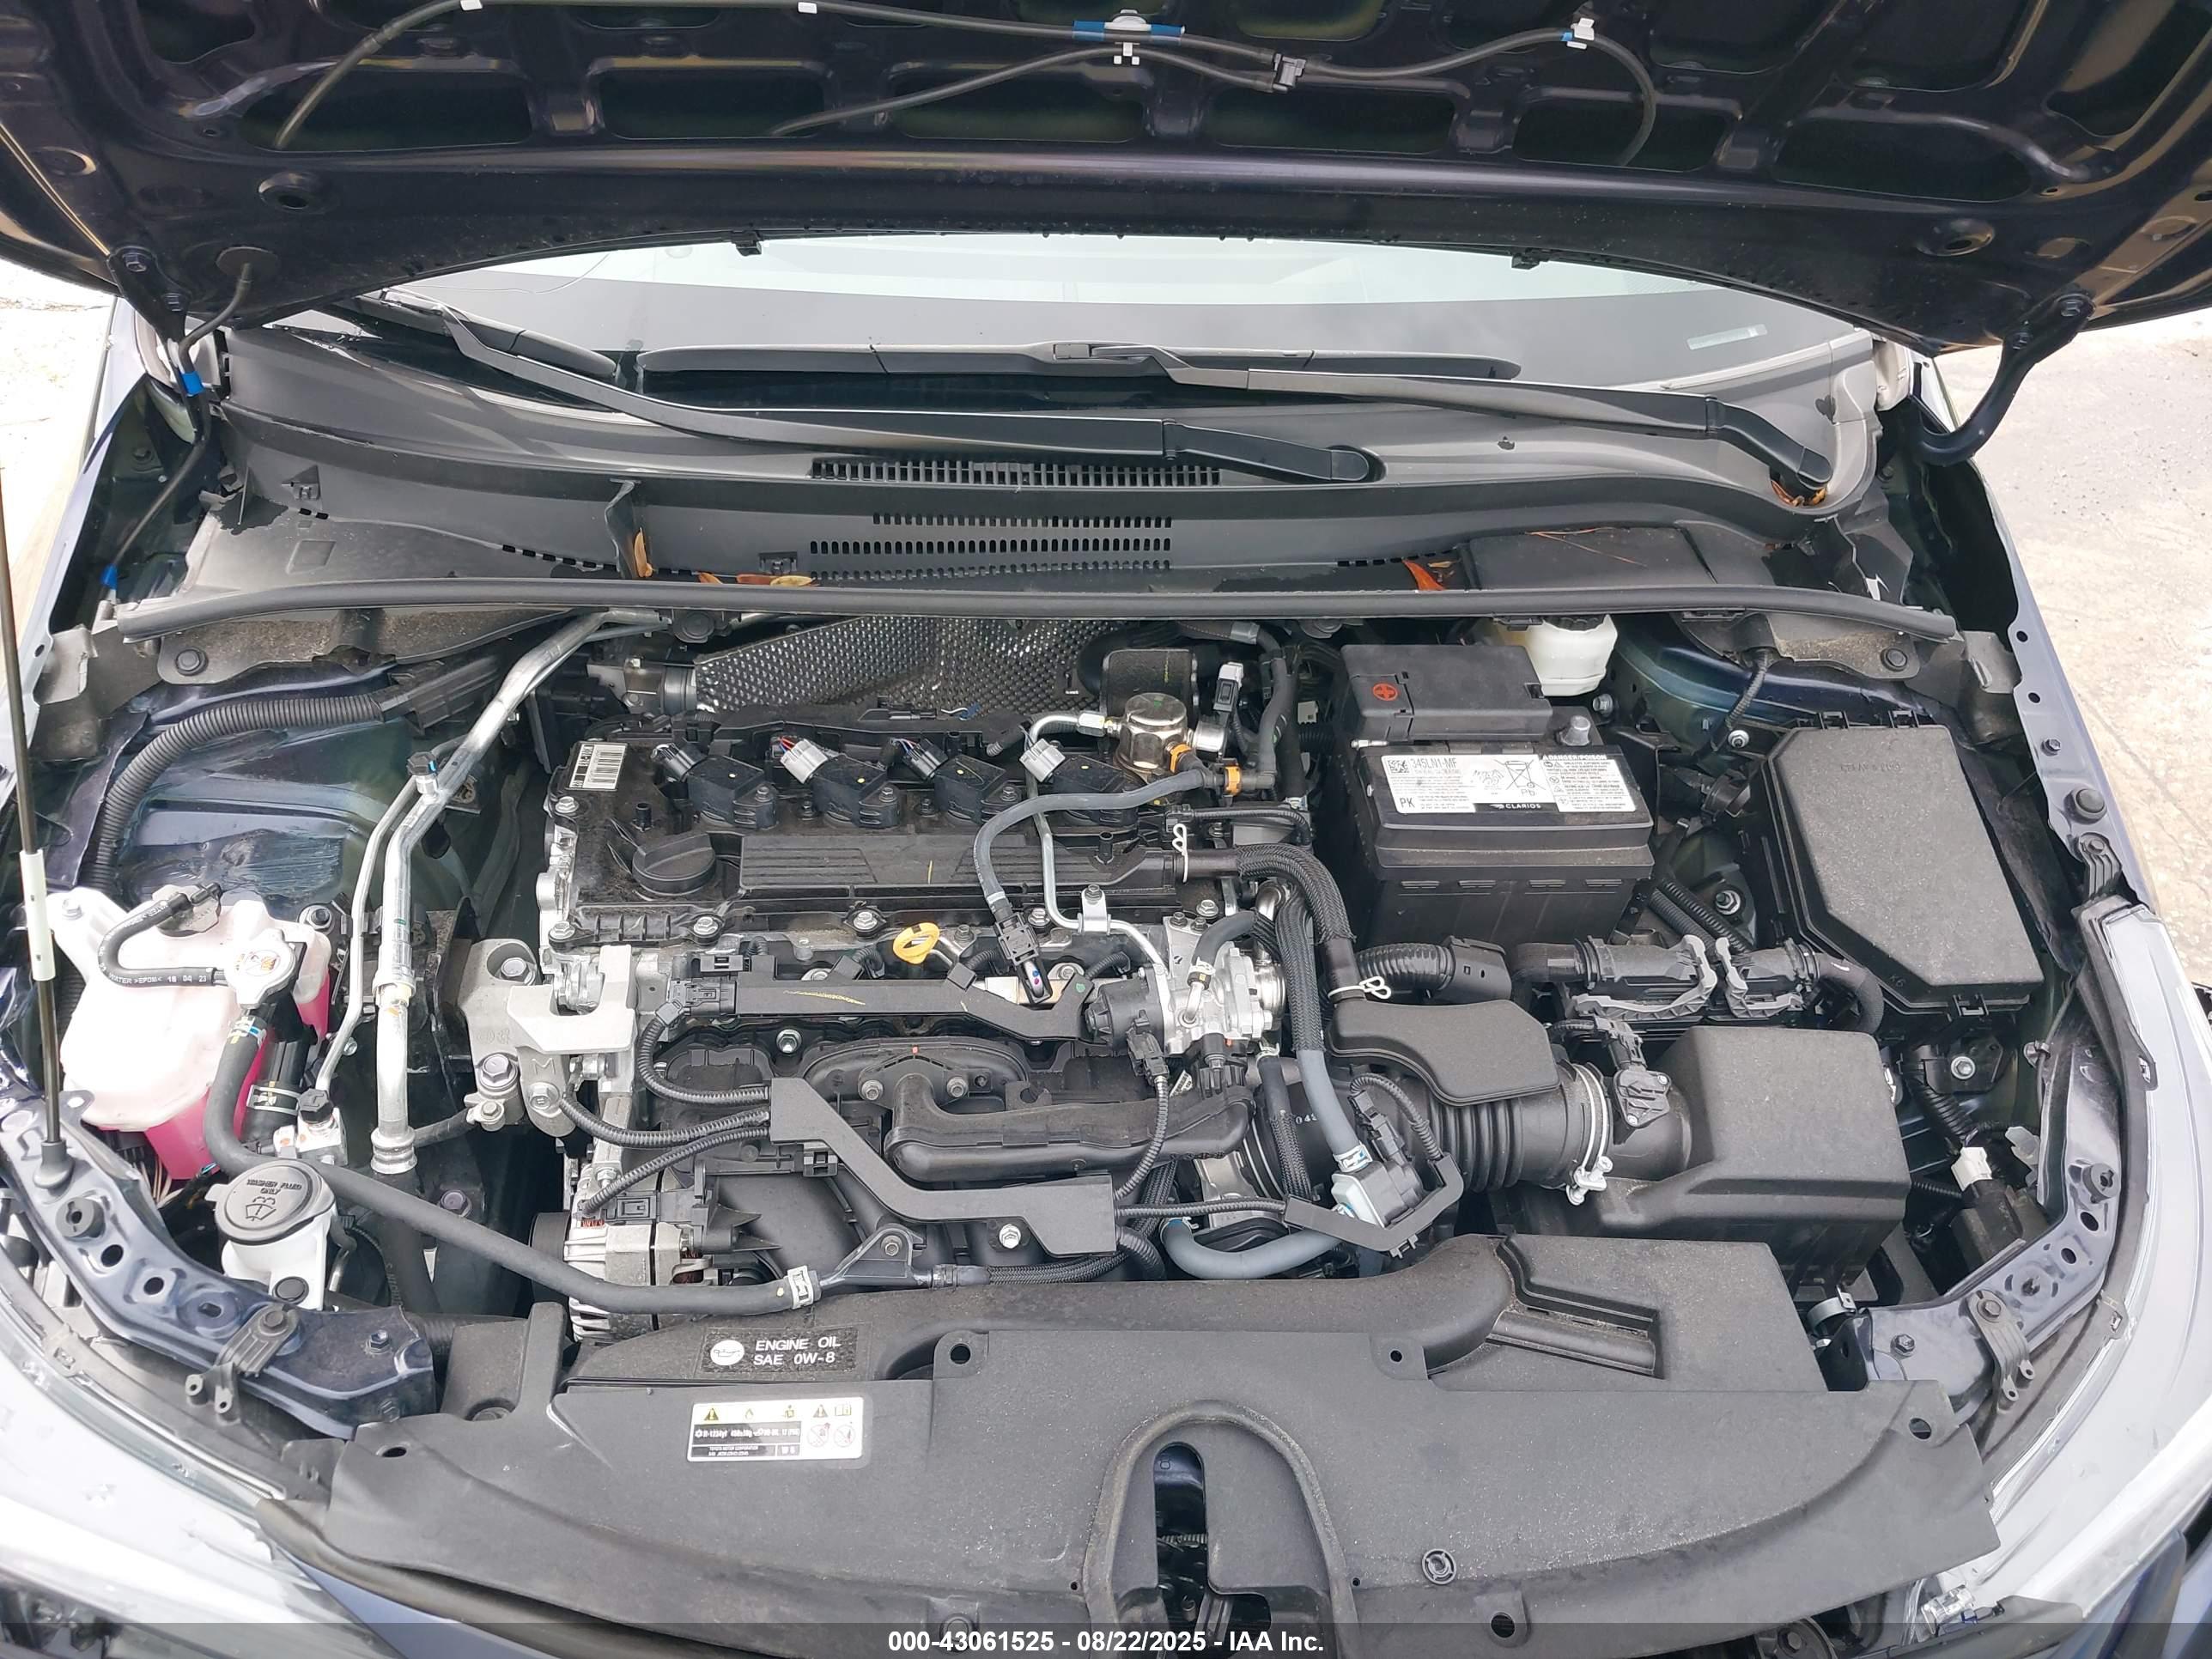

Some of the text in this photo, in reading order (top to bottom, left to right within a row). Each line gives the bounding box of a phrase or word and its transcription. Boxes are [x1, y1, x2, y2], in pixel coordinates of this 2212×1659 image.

[1400, 797, 1415, 808] PK
[755, 1336, 842, 1351] ENGINE OIL
[753, 1352, 836, 1365] SAE 0W-8
